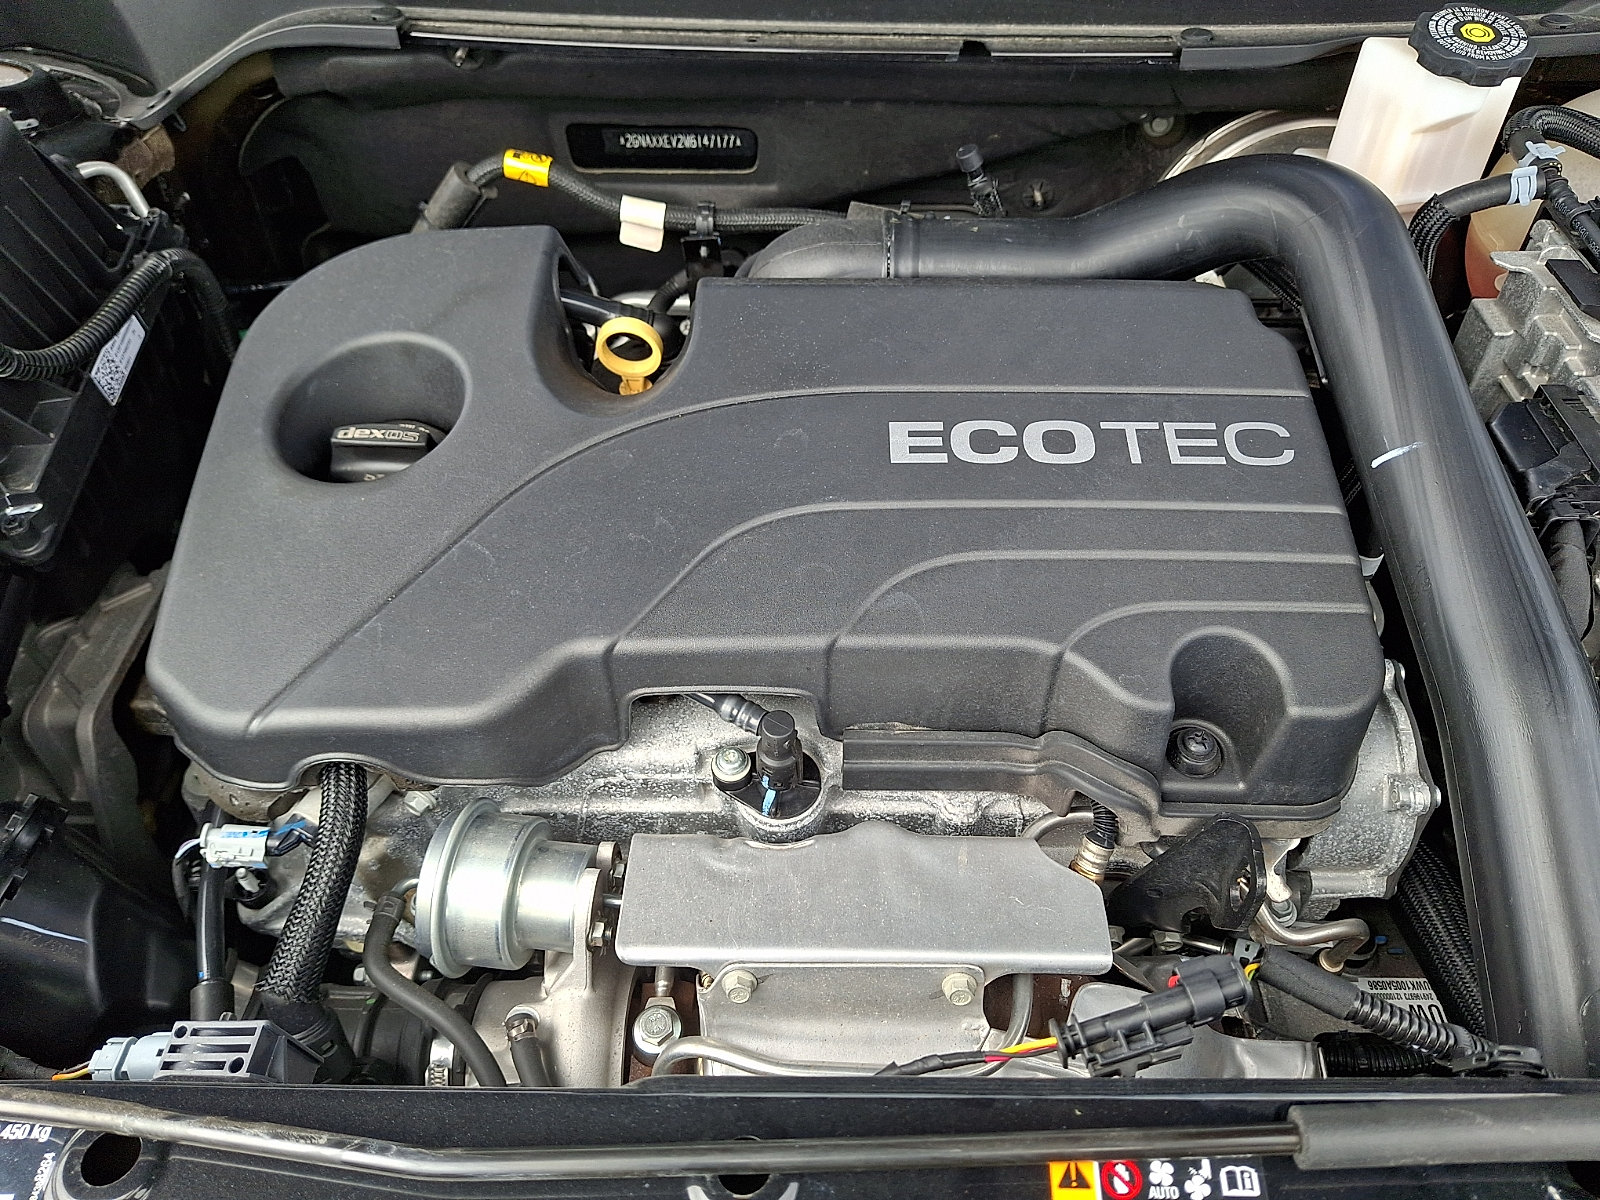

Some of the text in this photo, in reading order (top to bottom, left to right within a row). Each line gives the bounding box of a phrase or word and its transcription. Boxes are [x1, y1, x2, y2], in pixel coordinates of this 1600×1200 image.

[336, 427, 420, 442] dexos
[888, 420, 1295, 466] ECOTEC
[1148, 1186, 1180, 1200] AUTO
